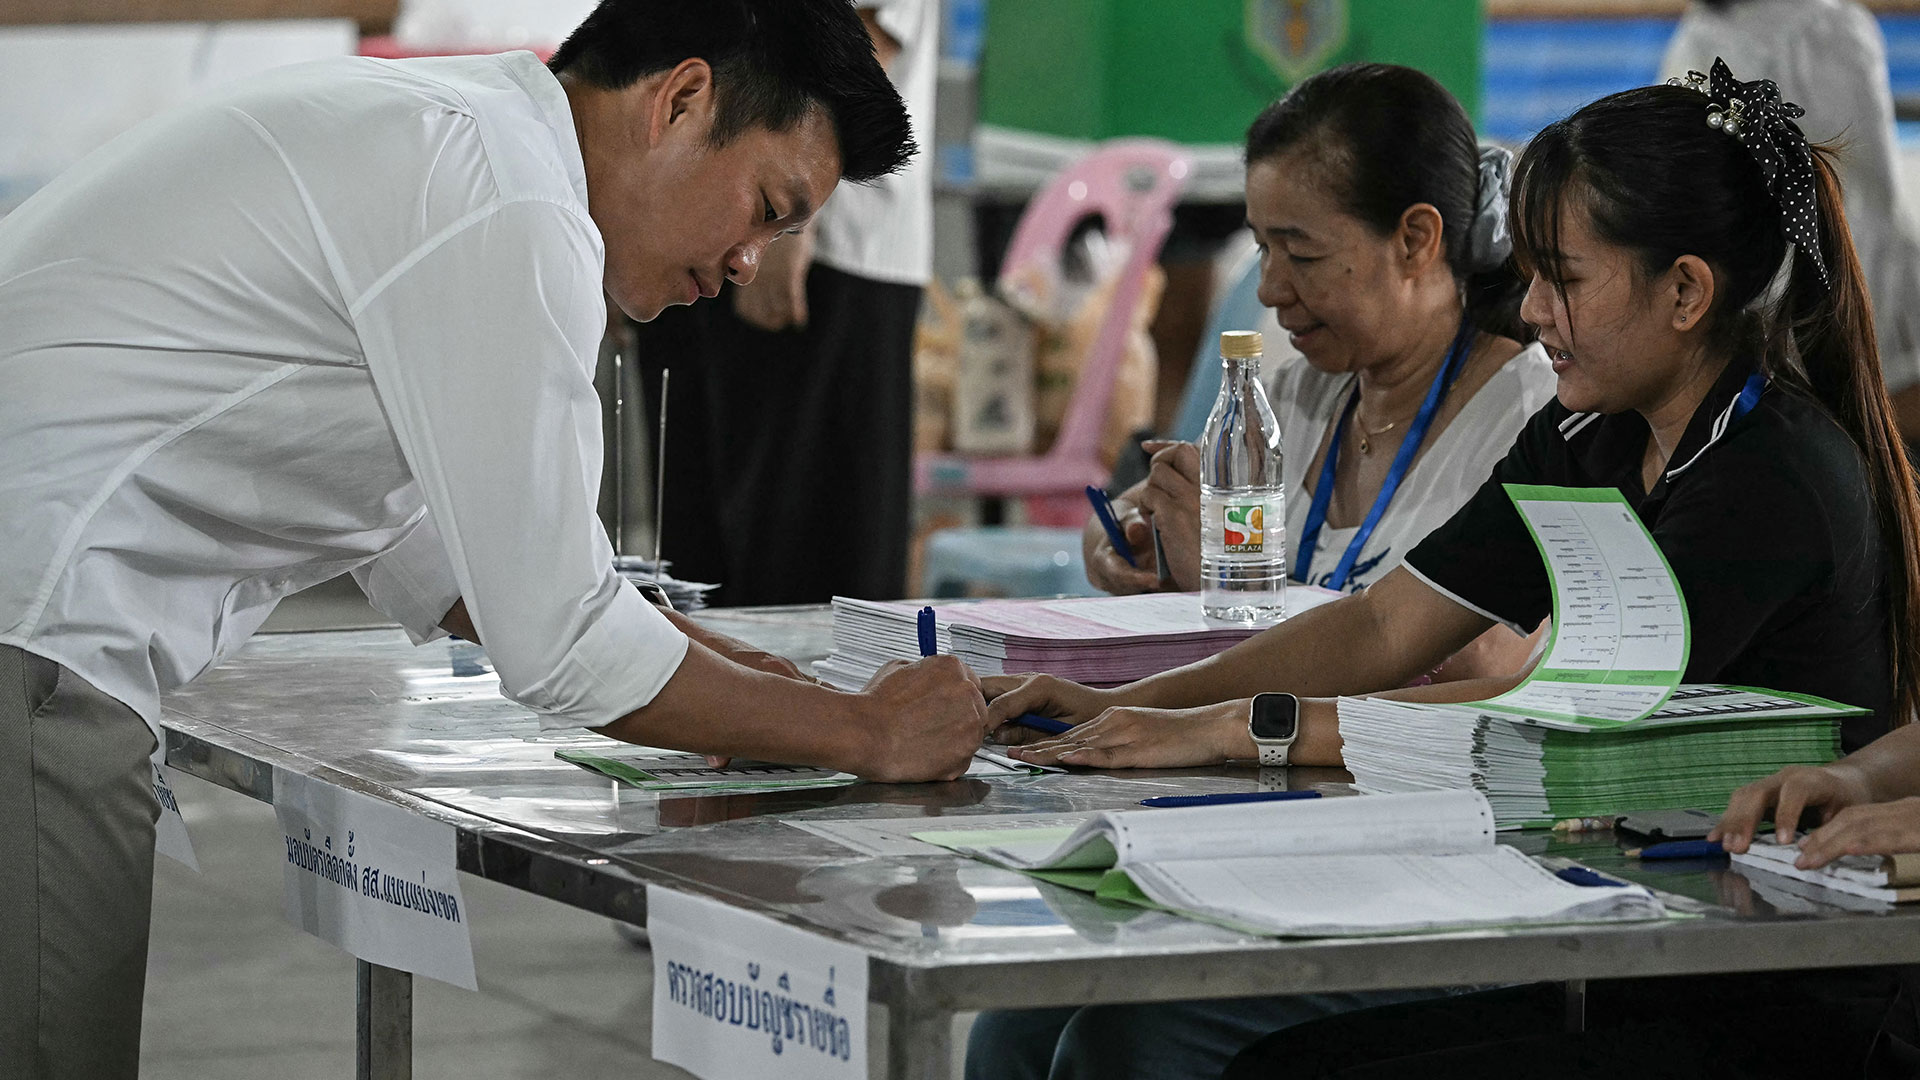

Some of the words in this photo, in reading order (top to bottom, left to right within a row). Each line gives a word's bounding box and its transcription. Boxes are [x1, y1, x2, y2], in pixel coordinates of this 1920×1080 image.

[285, 827, 358, 892] มอบบัตรเลือกตั้ง
[362, 866, 461, 923] สส.แบบแบ่งเขต
[667, 960, 851, 1061] ตรวจสอบบัญชีรายชื่อ
